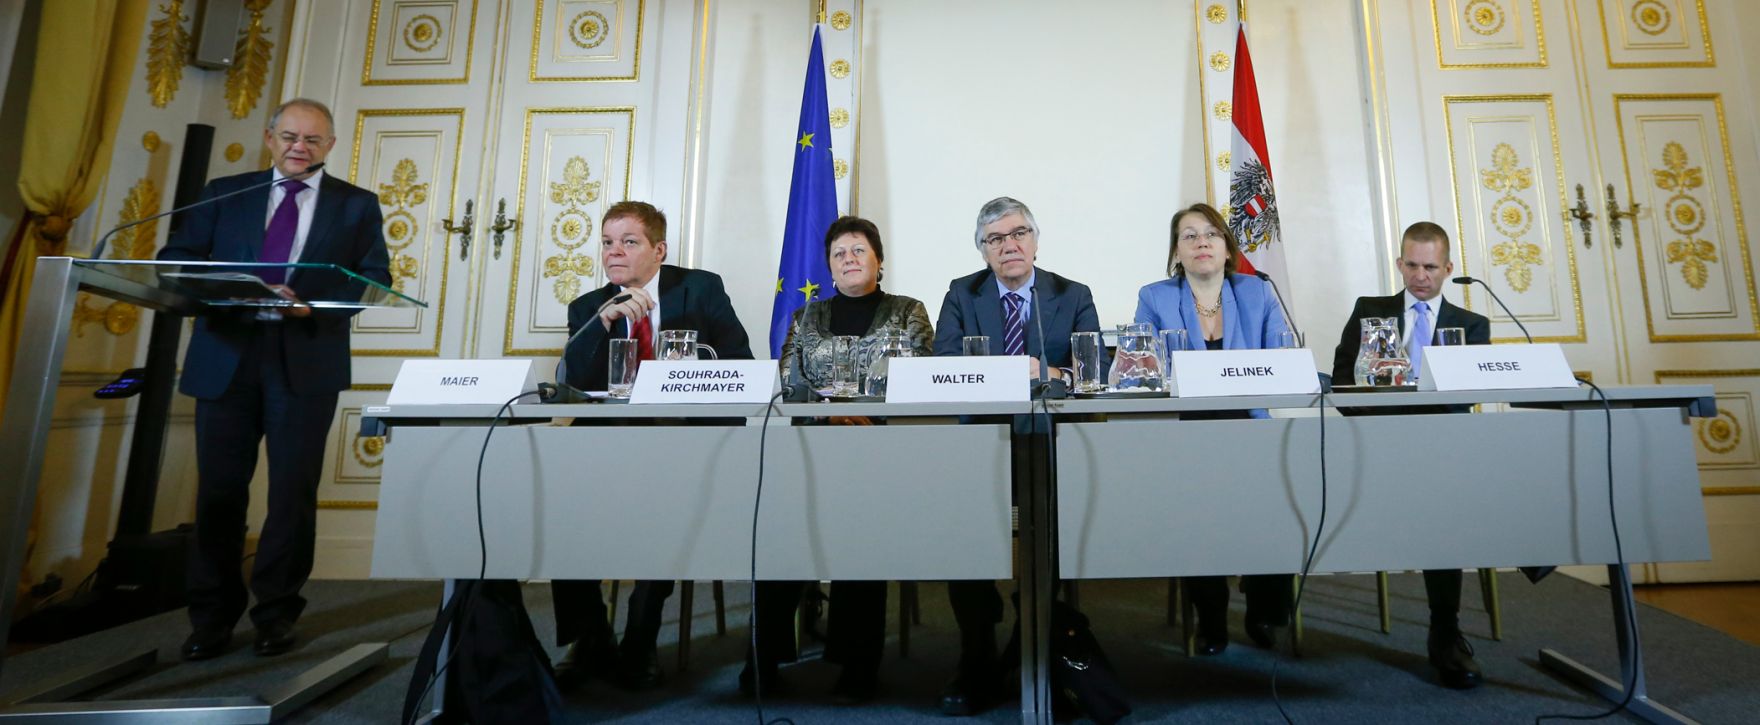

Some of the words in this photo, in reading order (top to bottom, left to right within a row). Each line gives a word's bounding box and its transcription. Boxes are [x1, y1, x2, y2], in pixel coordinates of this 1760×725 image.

[1220, 366, 1274, 377] JELINEK
[1478, 361, 1521, 372] HESSE
[668, 369, 744, 380] SOUHRADA-
[932, 373, 985, 384] WALTER
[440, 376, 479, 386] MAIER
[660, 382, 745, 393] KIRCHMAYER
